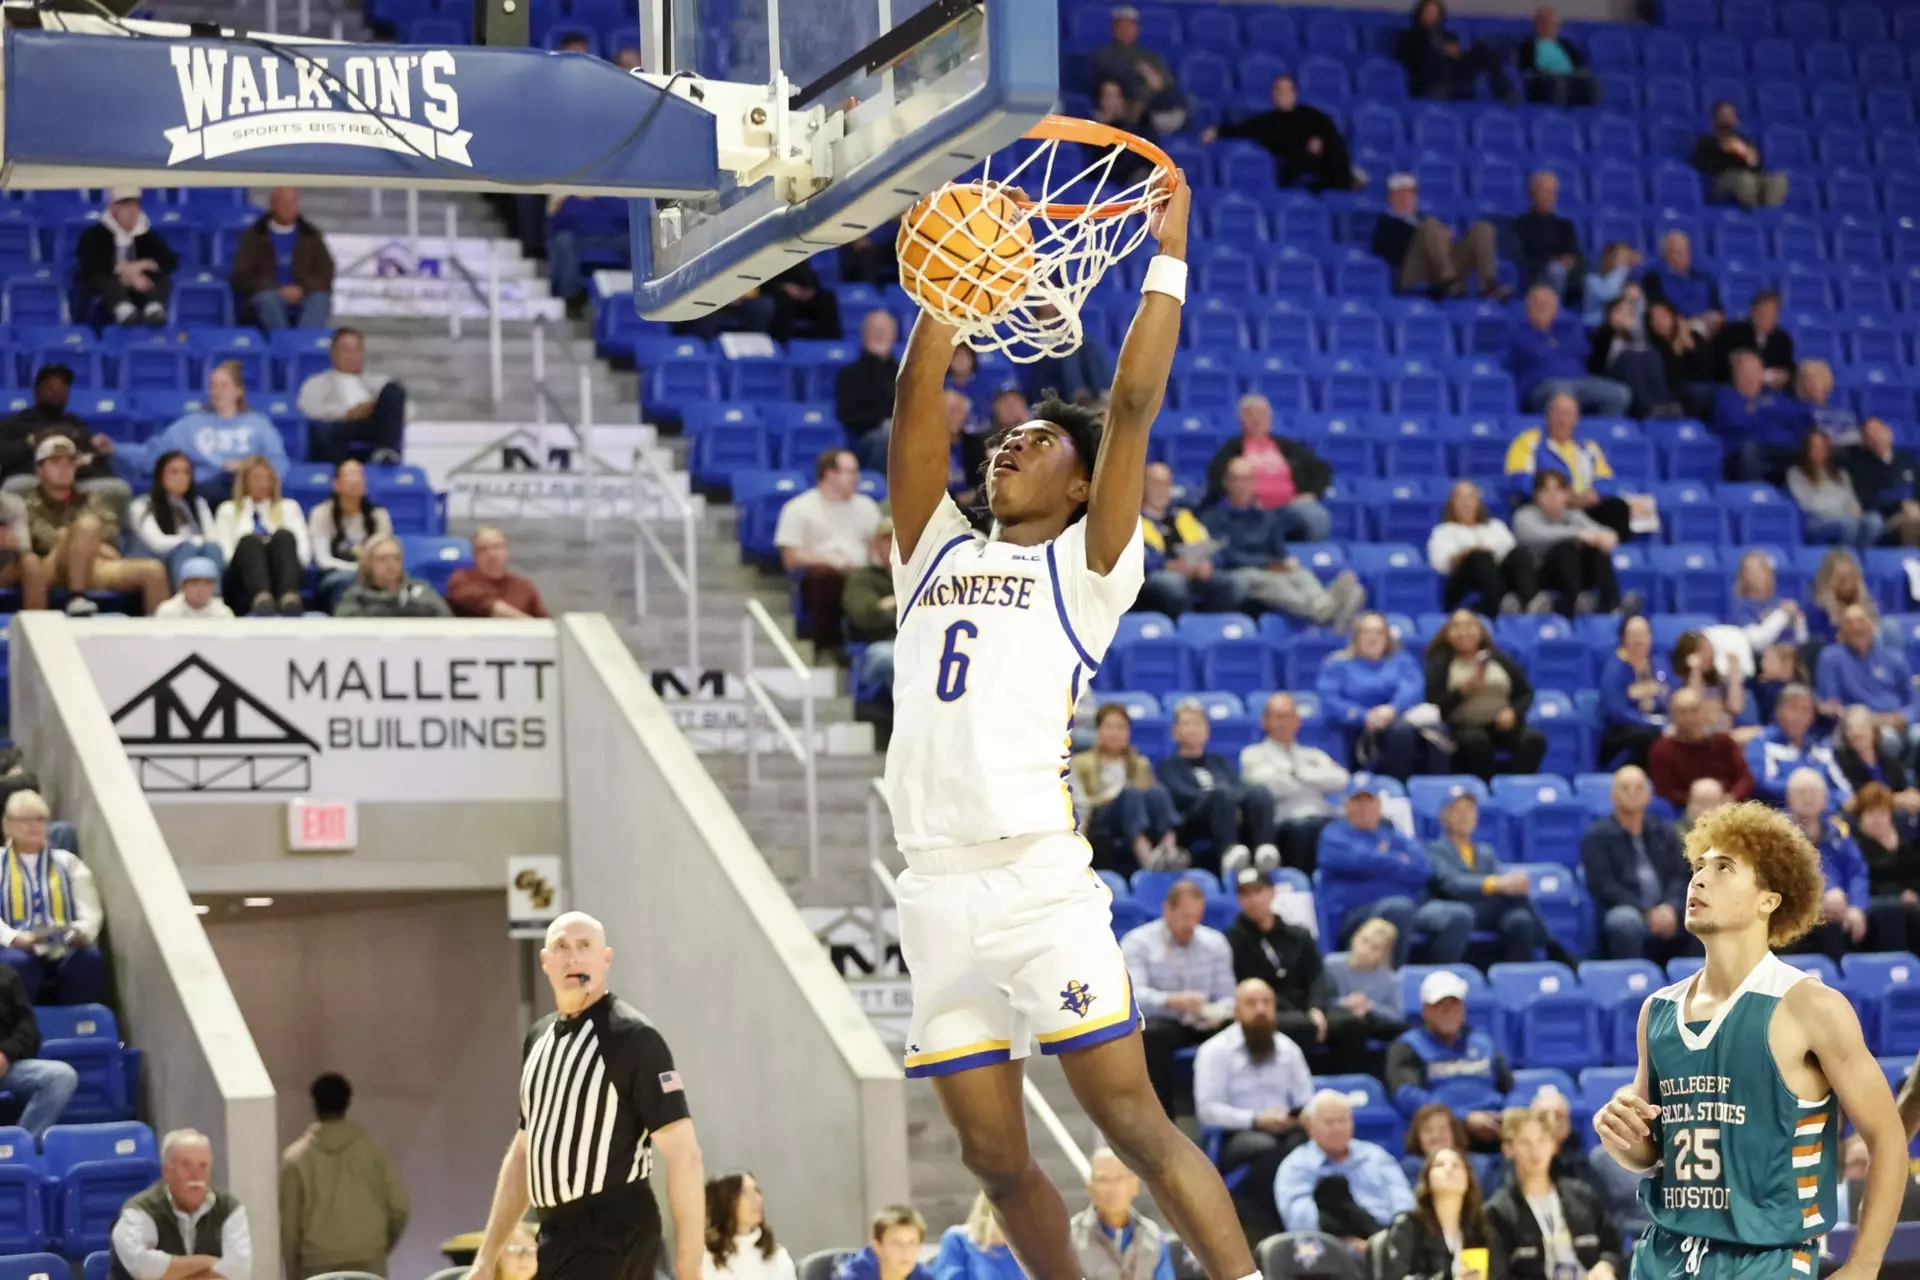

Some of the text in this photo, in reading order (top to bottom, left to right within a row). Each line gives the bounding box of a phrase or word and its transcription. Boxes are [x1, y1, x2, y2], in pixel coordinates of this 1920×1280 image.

[232, 122, 302, 140] SPORTS
[1011, 554, 1042, 562] SLC
[287, 658, 556, 702] MALLETT
[935, 619, 979, 703] 6
[328, 716, 547, 750] BUILDINGS
[301, 804, 348, 842] EXIT
[1672, 1127, 1722, 1182] 25
